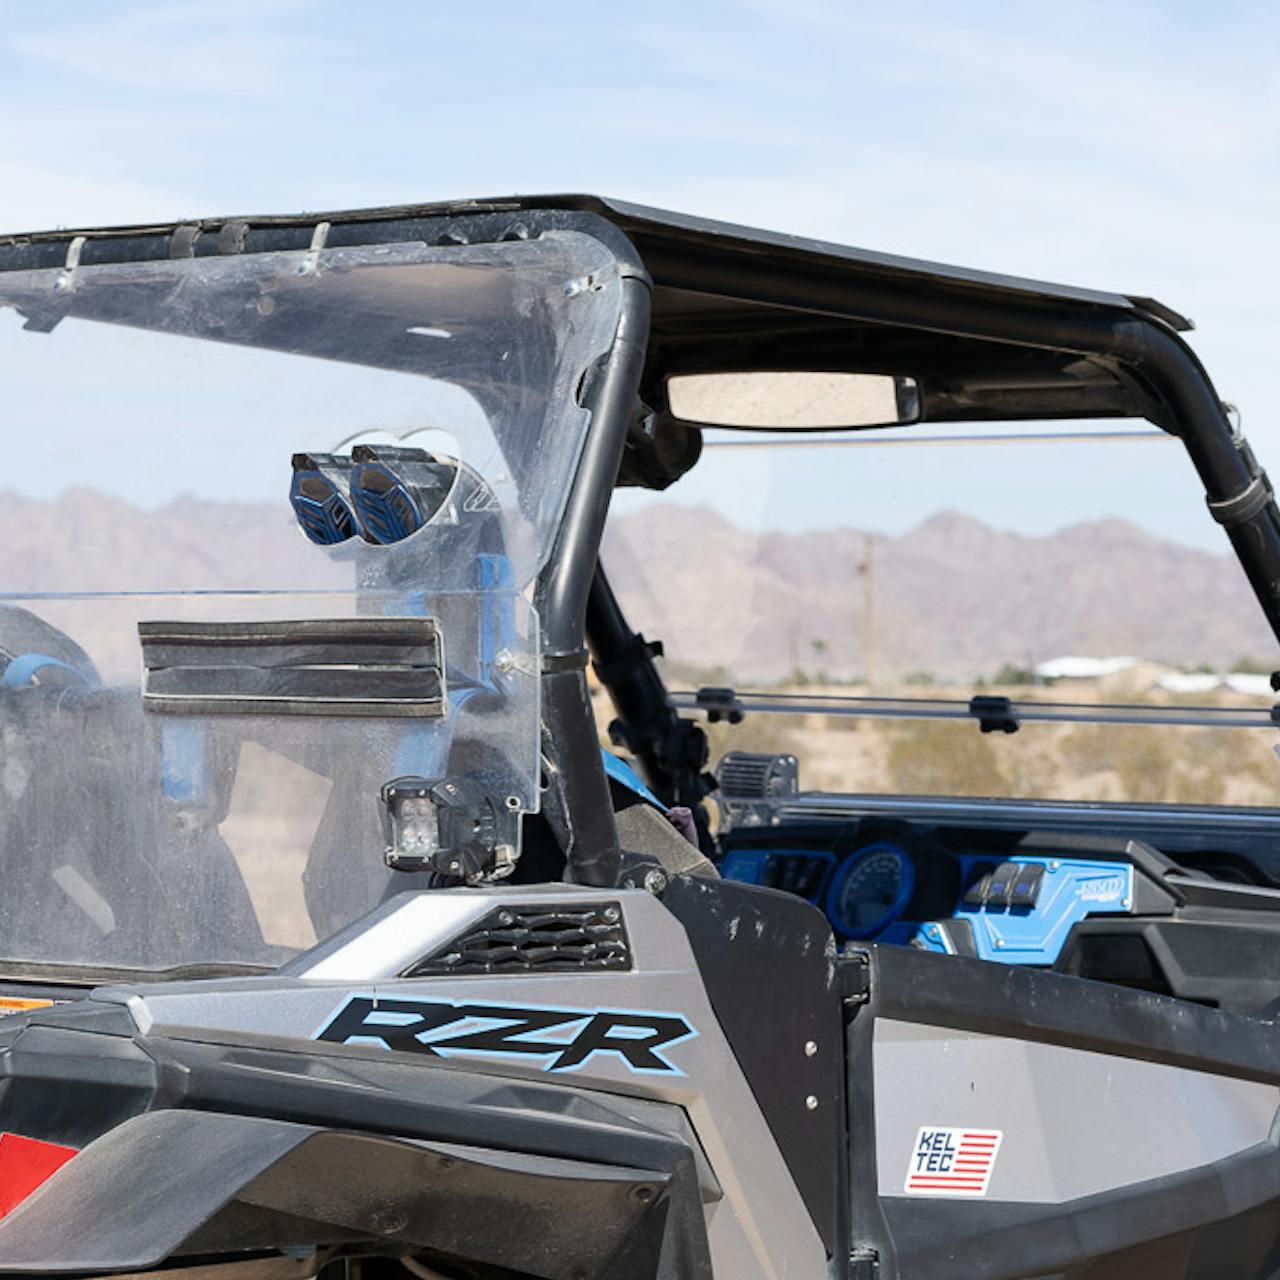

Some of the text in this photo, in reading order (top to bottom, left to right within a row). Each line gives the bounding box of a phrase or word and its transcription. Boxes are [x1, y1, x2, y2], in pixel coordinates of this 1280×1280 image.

[312, 993, 700, 1076] RZR
[919, 1132, 955, 1151] KEL
[917, 1153, 954, 1172] TEC
